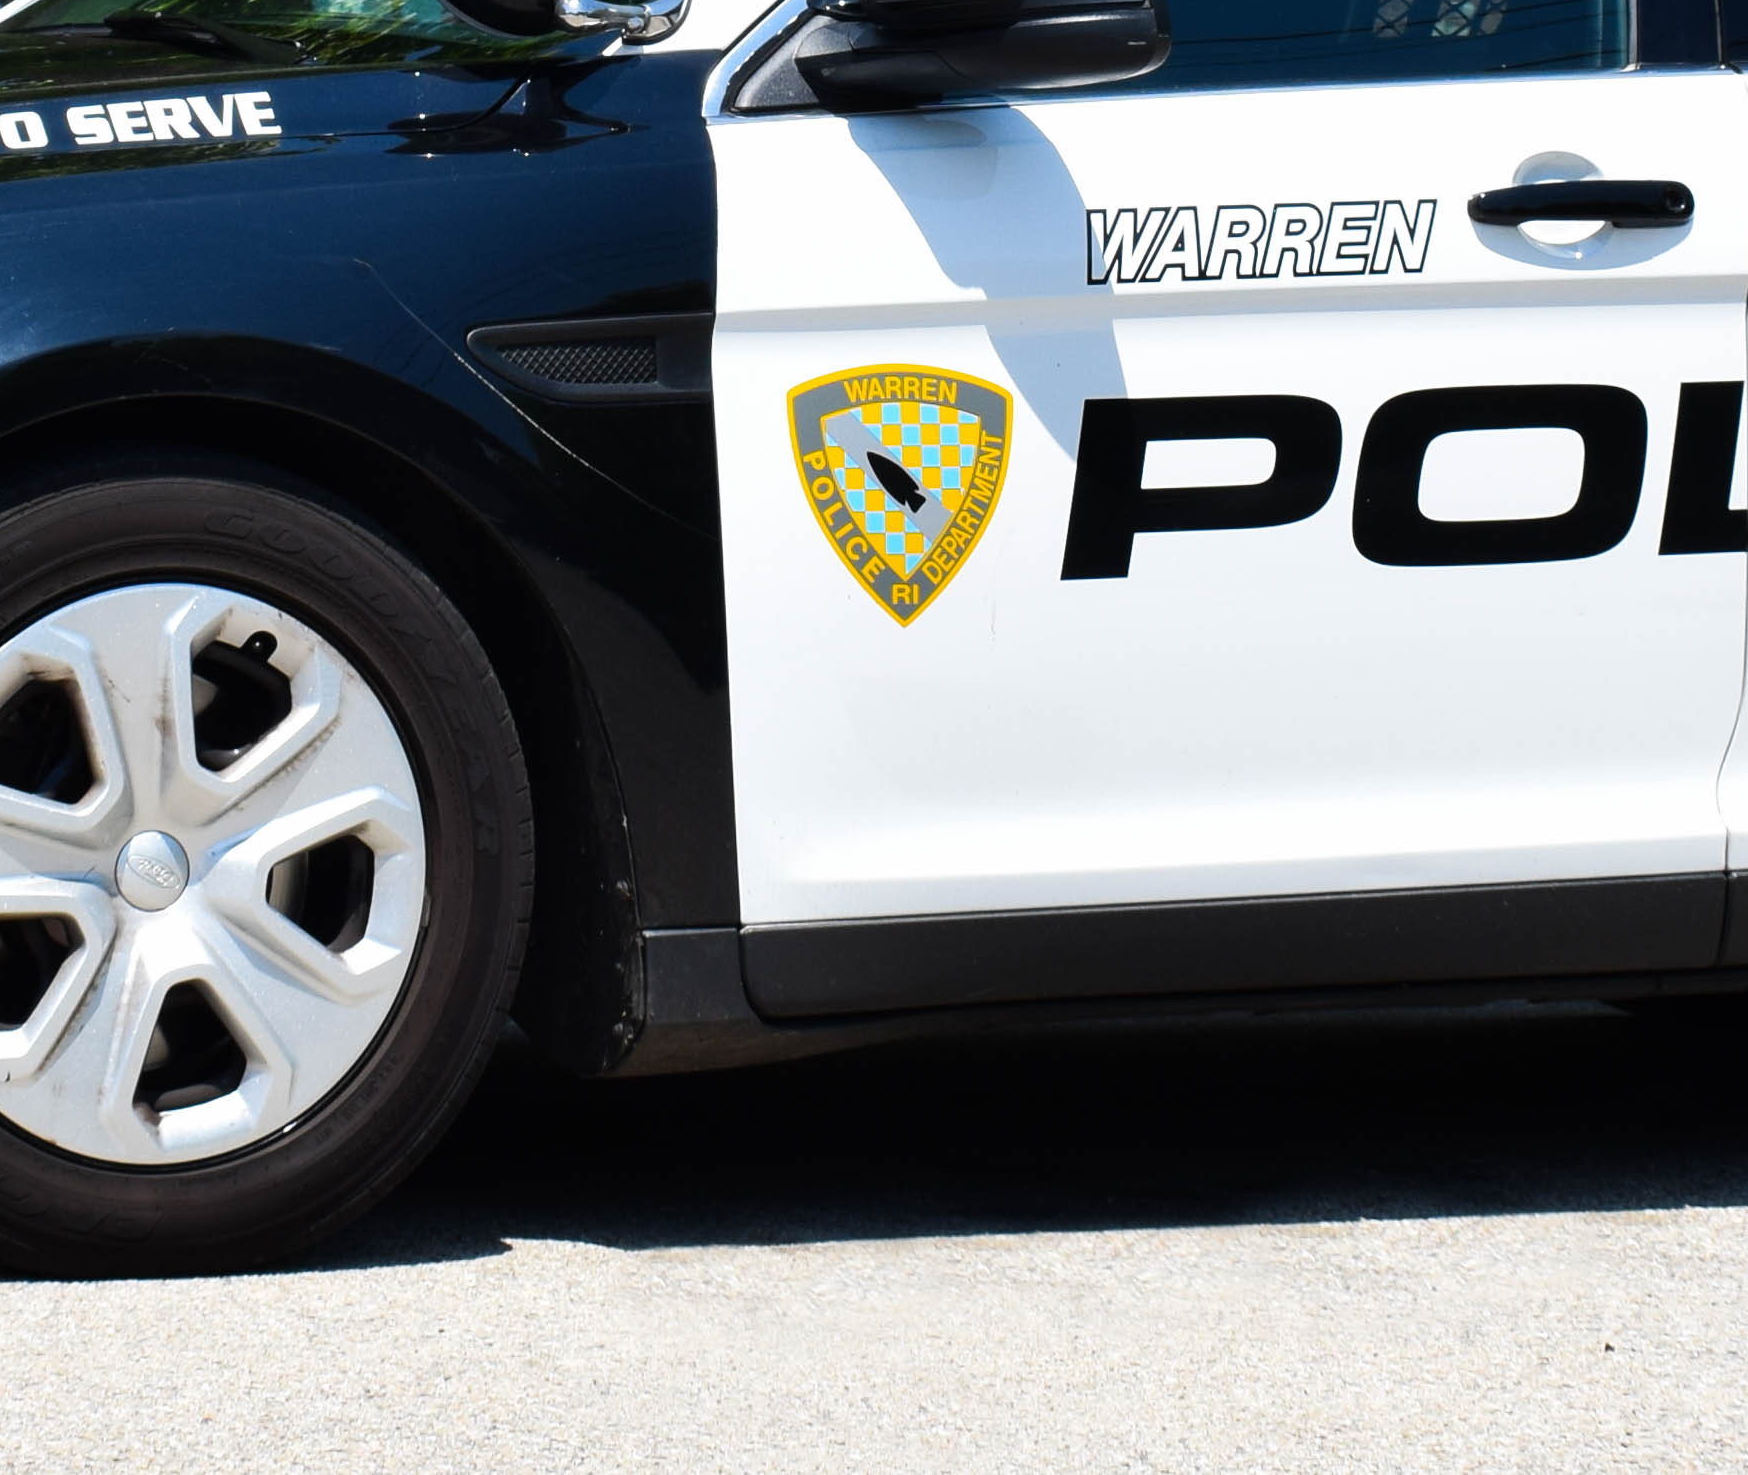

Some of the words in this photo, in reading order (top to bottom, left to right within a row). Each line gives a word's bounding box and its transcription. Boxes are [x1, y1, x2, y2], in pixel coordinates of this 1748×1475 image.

[66, 91, 283, 146] SERVE
[1085, 199, 1438, 286] WARREN
[844, 376, 958, 404] WARREN
[802, 450, 886, 583] POLICE
[921, 430, 1003, 585] DEPARTMENT
[892, 583, 919, 605] RI
